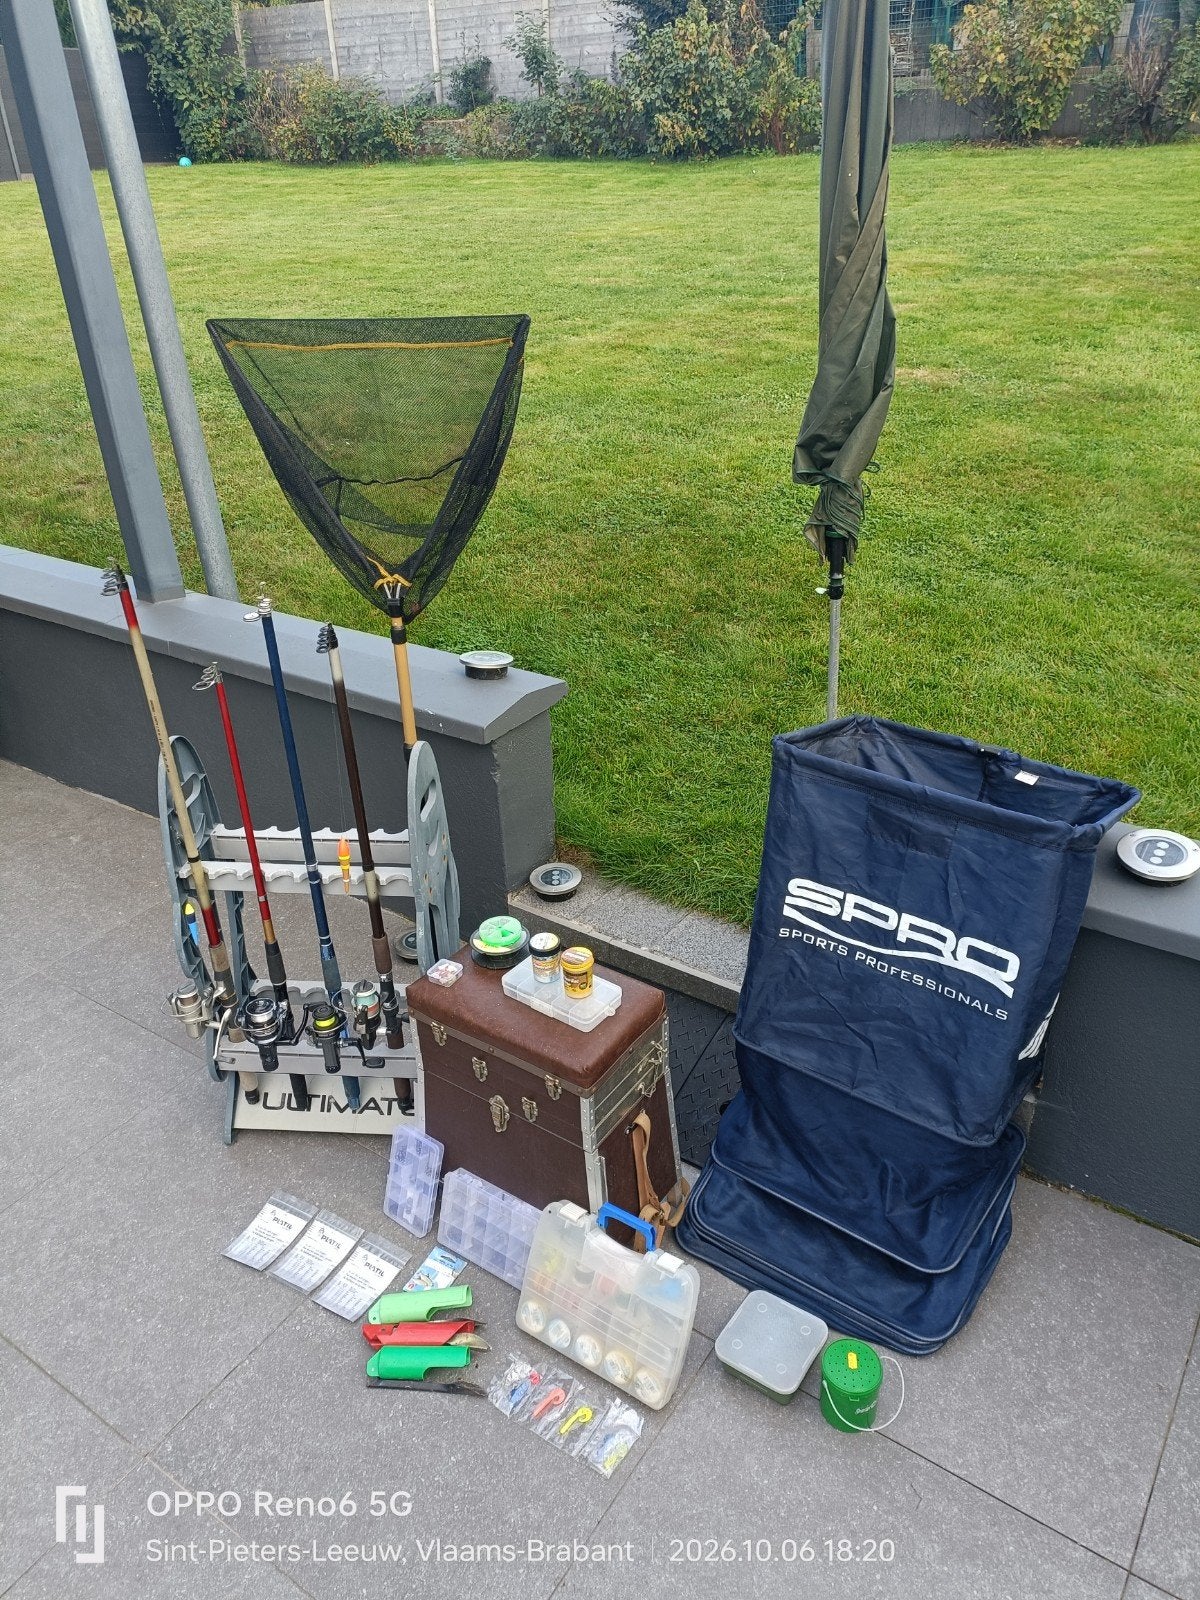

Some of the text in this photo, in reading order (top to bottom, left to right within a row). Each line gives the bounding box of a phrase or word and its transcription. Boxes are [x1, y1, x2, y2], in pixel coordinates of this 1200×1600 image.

[779, 927, 1008, 1021] SPORTS PROFESSIONALS
[783, 877, 1021, 998] SPRO
